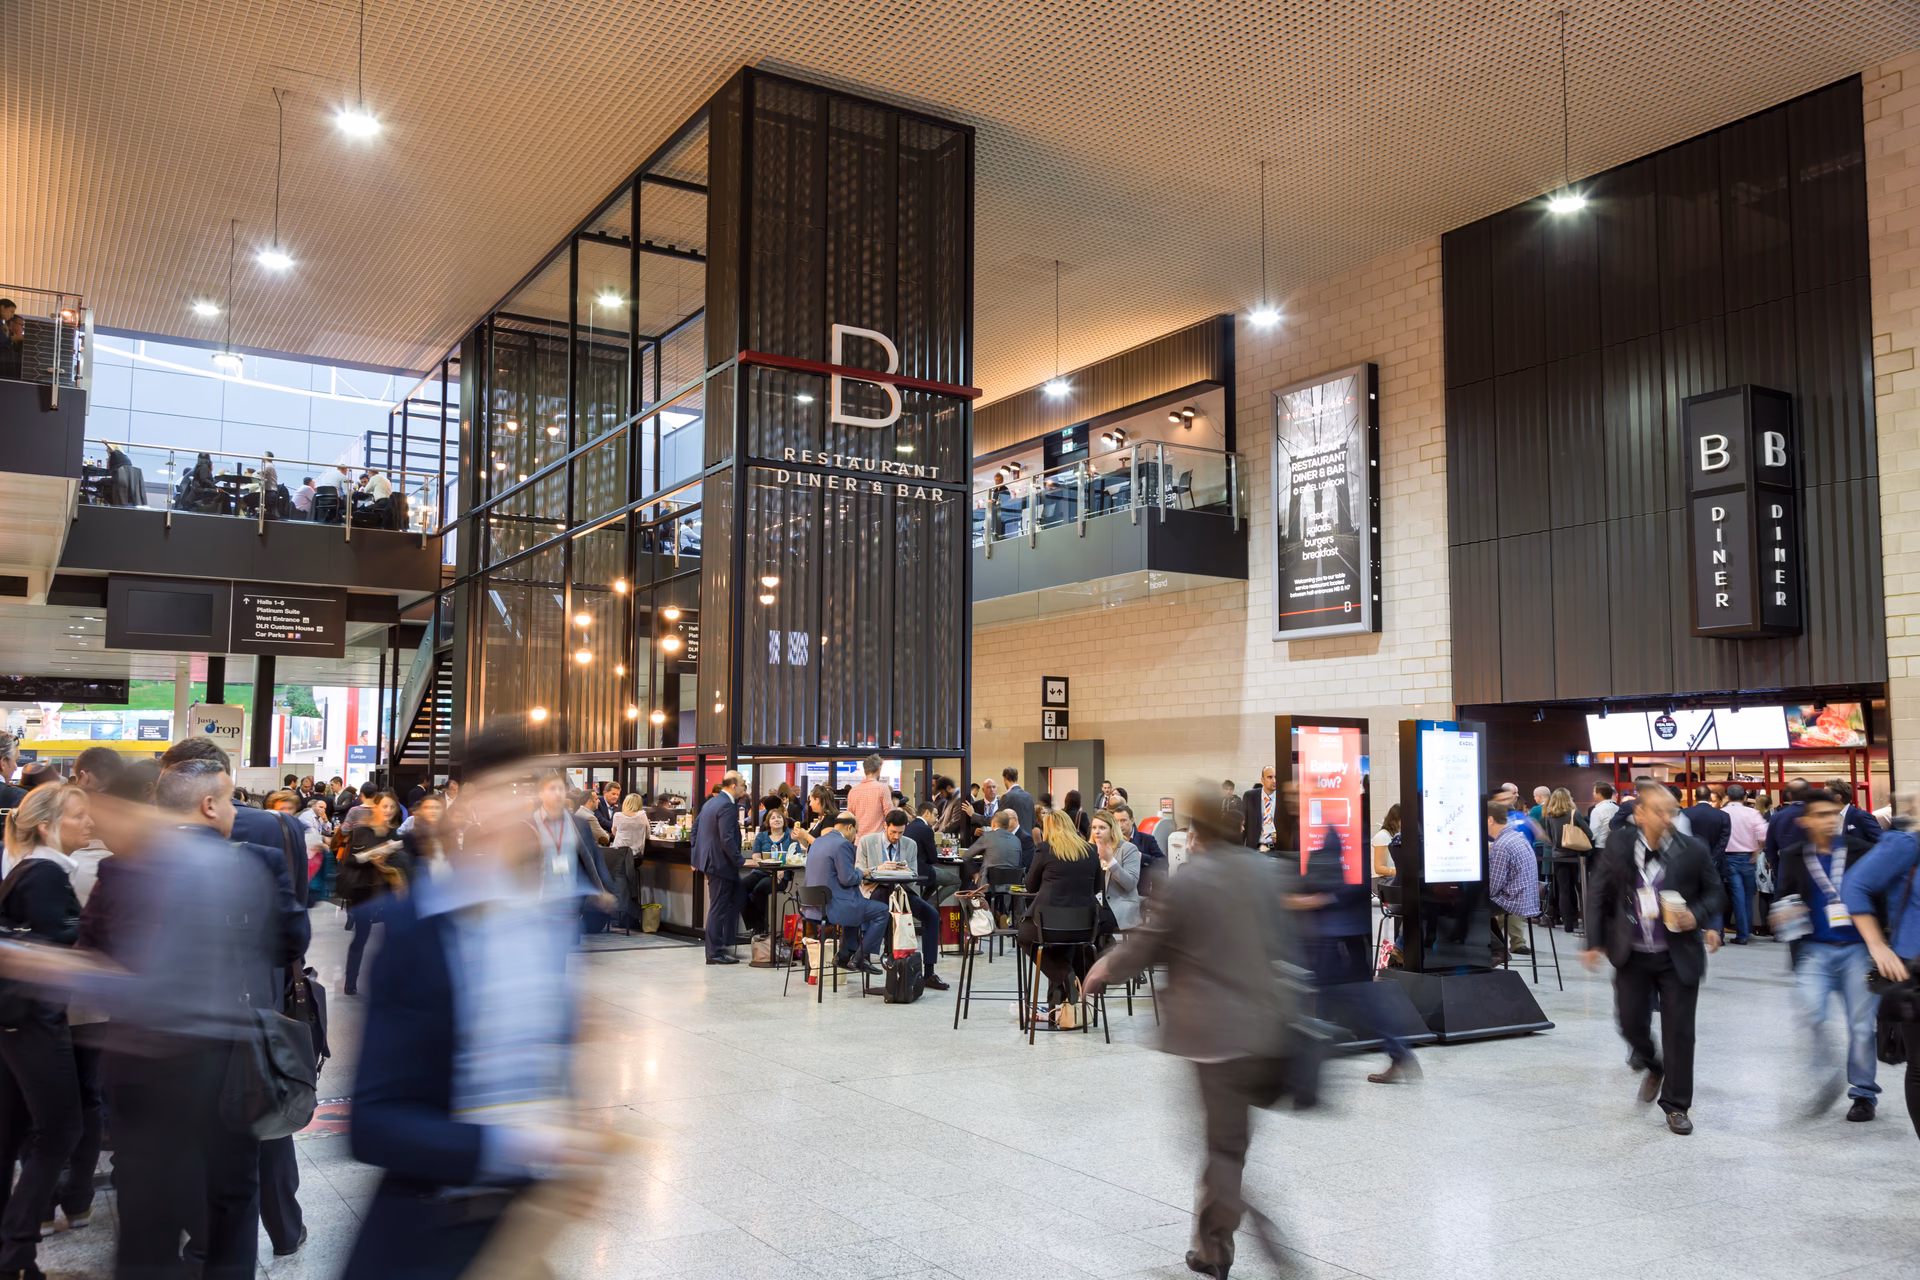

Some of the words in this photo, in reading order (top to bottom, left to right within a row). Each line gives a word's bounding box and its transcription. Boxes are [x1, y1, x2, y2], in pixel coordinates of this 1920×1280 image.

[832, 323, 902, 428] B
[1296, 441, 1340, 459] AMERICAN
[1699, 434, 1730, 471] B
[1763, 431, 1787, 467] B
[784, 447, 939, 479] RESTAURANT
[1291, 451, 1346, 472] RESTAURANT
[1292, 469, 1318, 484] DINER
[1319, 468, 1325, 478] &
[1326, 463, 1345, 476] BAR
[777, 469, 857, 492] DINER
[872, 481, 883, 494] &
[898, 484, 943, 501] BAR
[1318, 477, 1345, 490] LONDON
[1308, 509, 1330, 521] steak
[1306, 522, 1332, 535] salads
[1304, 535, 1334, 549] burgers
[1302, 546, 1339, 560] breakfast
[1711, 506, 1729, 608] DINER
[1771, 504, 1787, 606] DINER
[1344, 601, 1352, 612] B
[1310, 760, 1348, 775] Battery
[1317, 776, 1342, 788] low?
